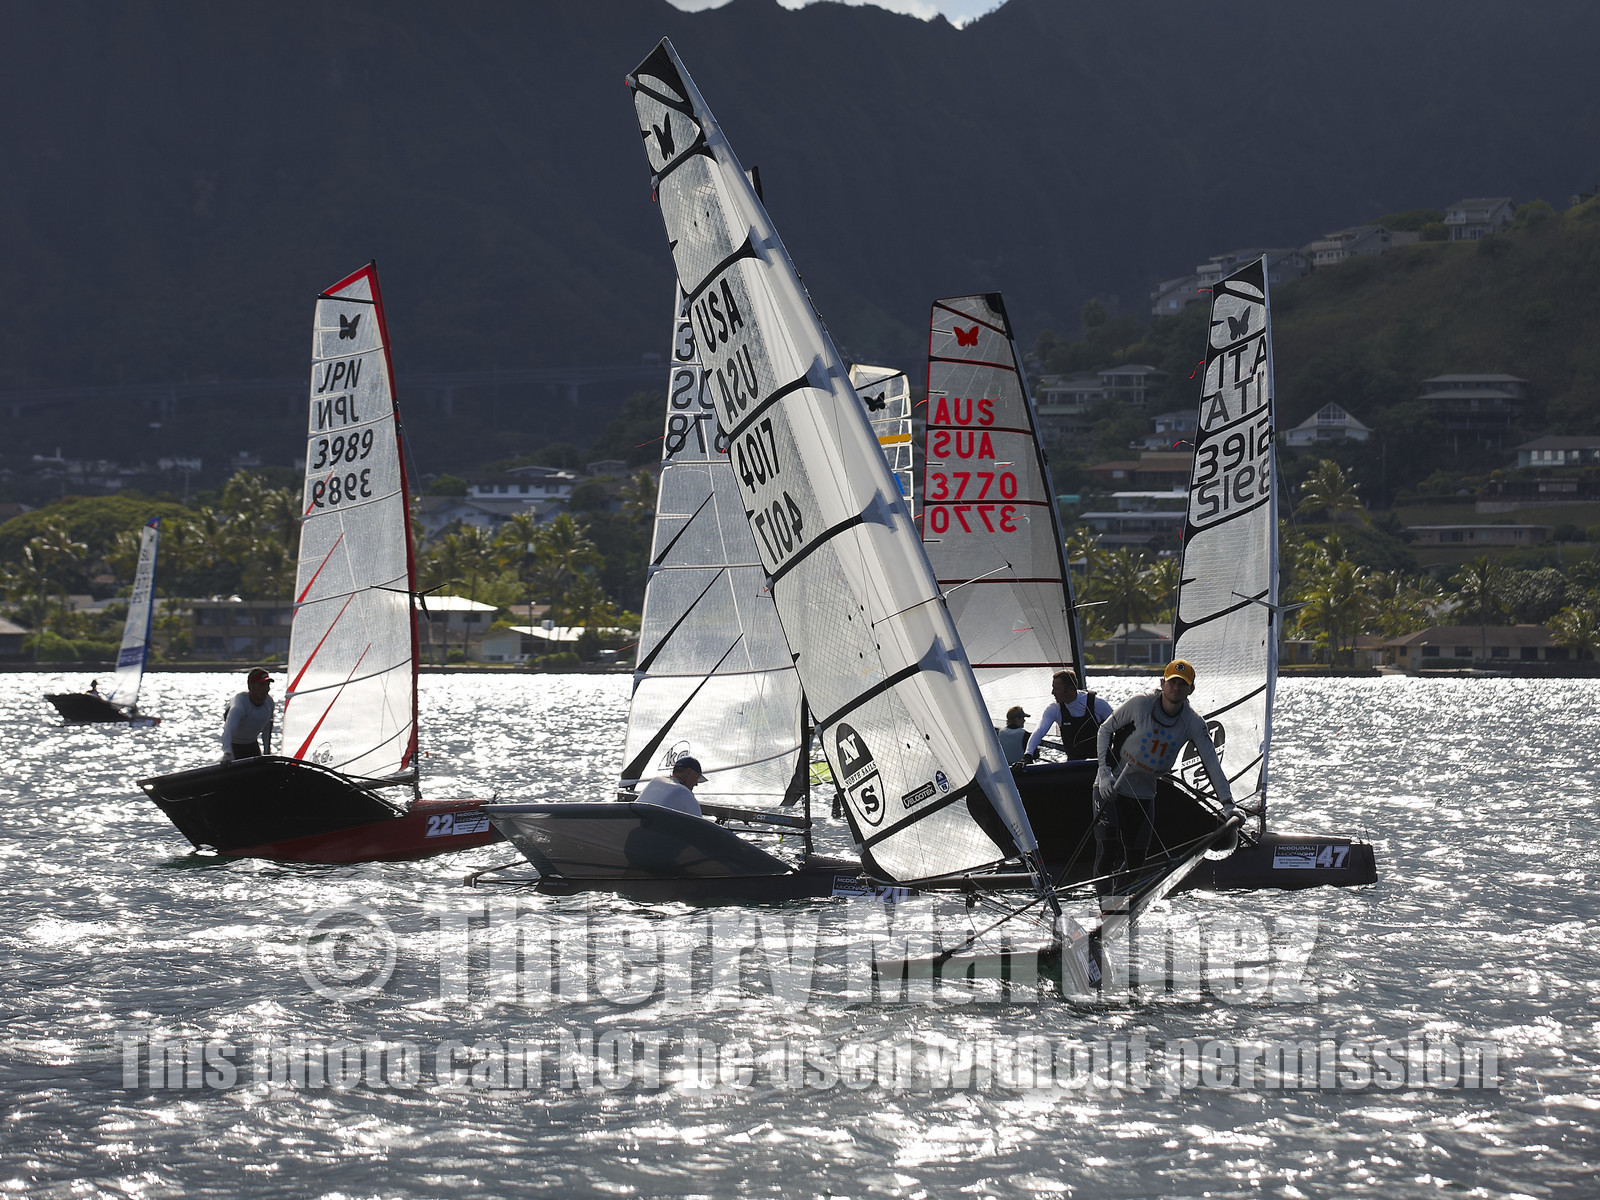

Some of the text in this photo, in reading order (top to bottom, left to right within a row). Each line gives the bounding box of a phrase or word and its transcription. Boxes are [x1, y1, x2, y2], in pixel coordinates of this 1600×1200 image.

[695, 277, 744, 353] USA
[318, 358, 362, 393] JPN
[1218, 335, 1267, 389] ITA
[933, 397, 995, 426] AUS
[313, 428, 374, 470] 3989
[737, 417, 780, 494] 4017
[1197, 418, 1271, 484] 3912
[930, 472, 1018, 501] 3770
[839, 733, 860, 766] N
[1150, 740, 1168, 757] 11
[845, 761, 877, 787] NORTH SAILS
[861, 784, 880, 815] S
[426, 813, 454, 837] 22
[1316, 845, 1350, 868] 47
